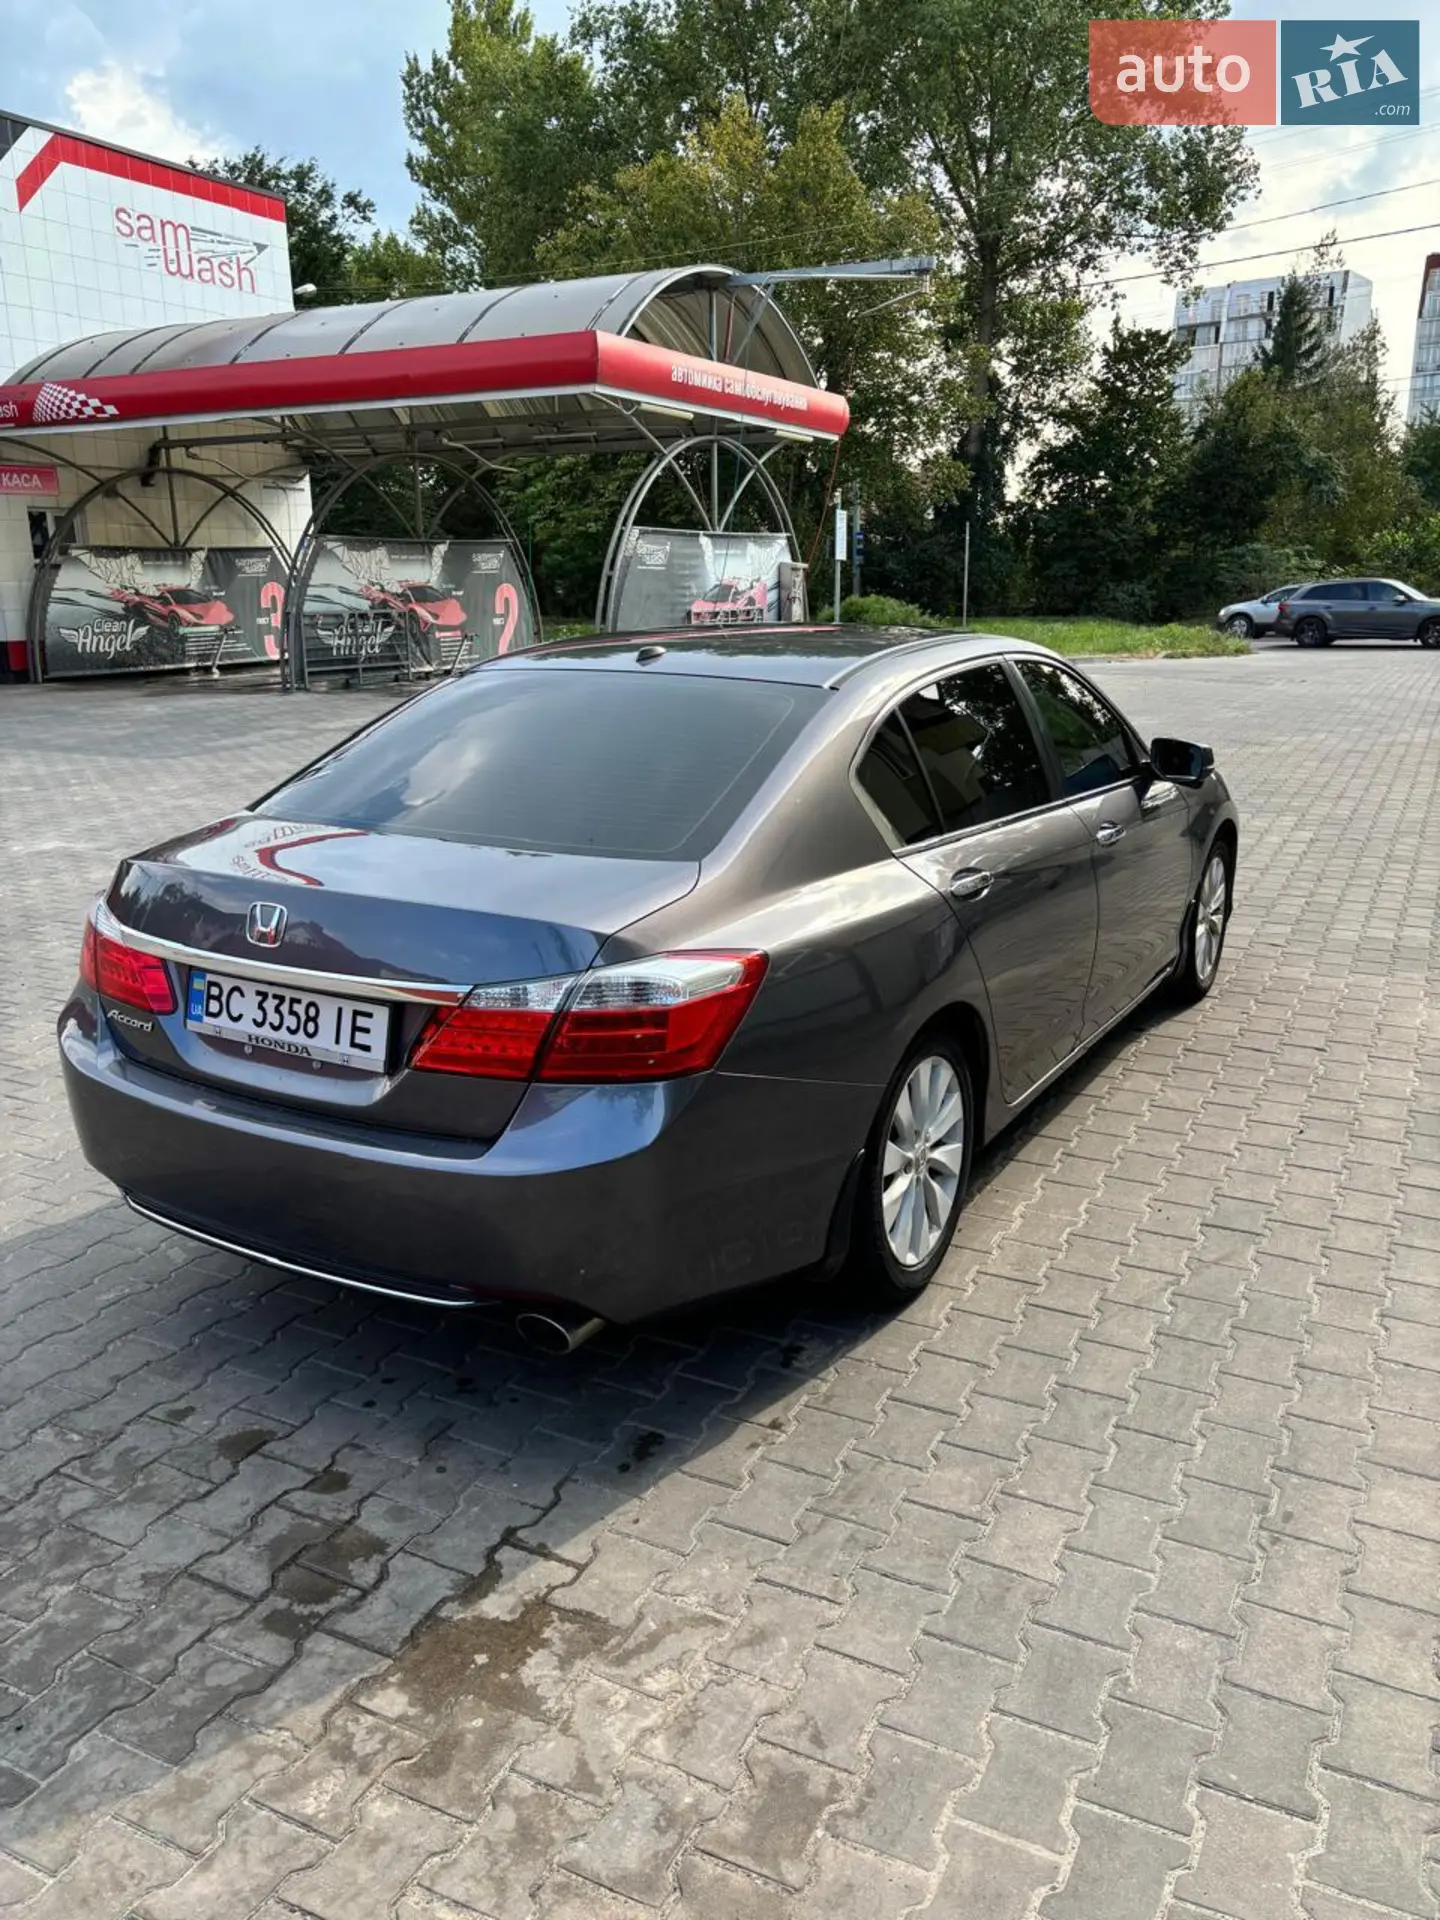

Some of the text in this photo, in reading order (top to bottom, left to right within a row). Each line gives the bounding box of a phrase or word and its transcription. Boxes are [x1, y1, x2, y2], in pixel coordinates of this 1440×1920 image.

[114, 206, 192, 251] sam
[2, 472, 42, 489] КАСА
[94, 619, 127, 633] Clean
[78, 619, 134, 660] Angel
[107, 1008, 153, 1032] Accord
[205, 980, 374, 1053] BC 3358 IE
[248, 1034, 312, 1057] HONDA
